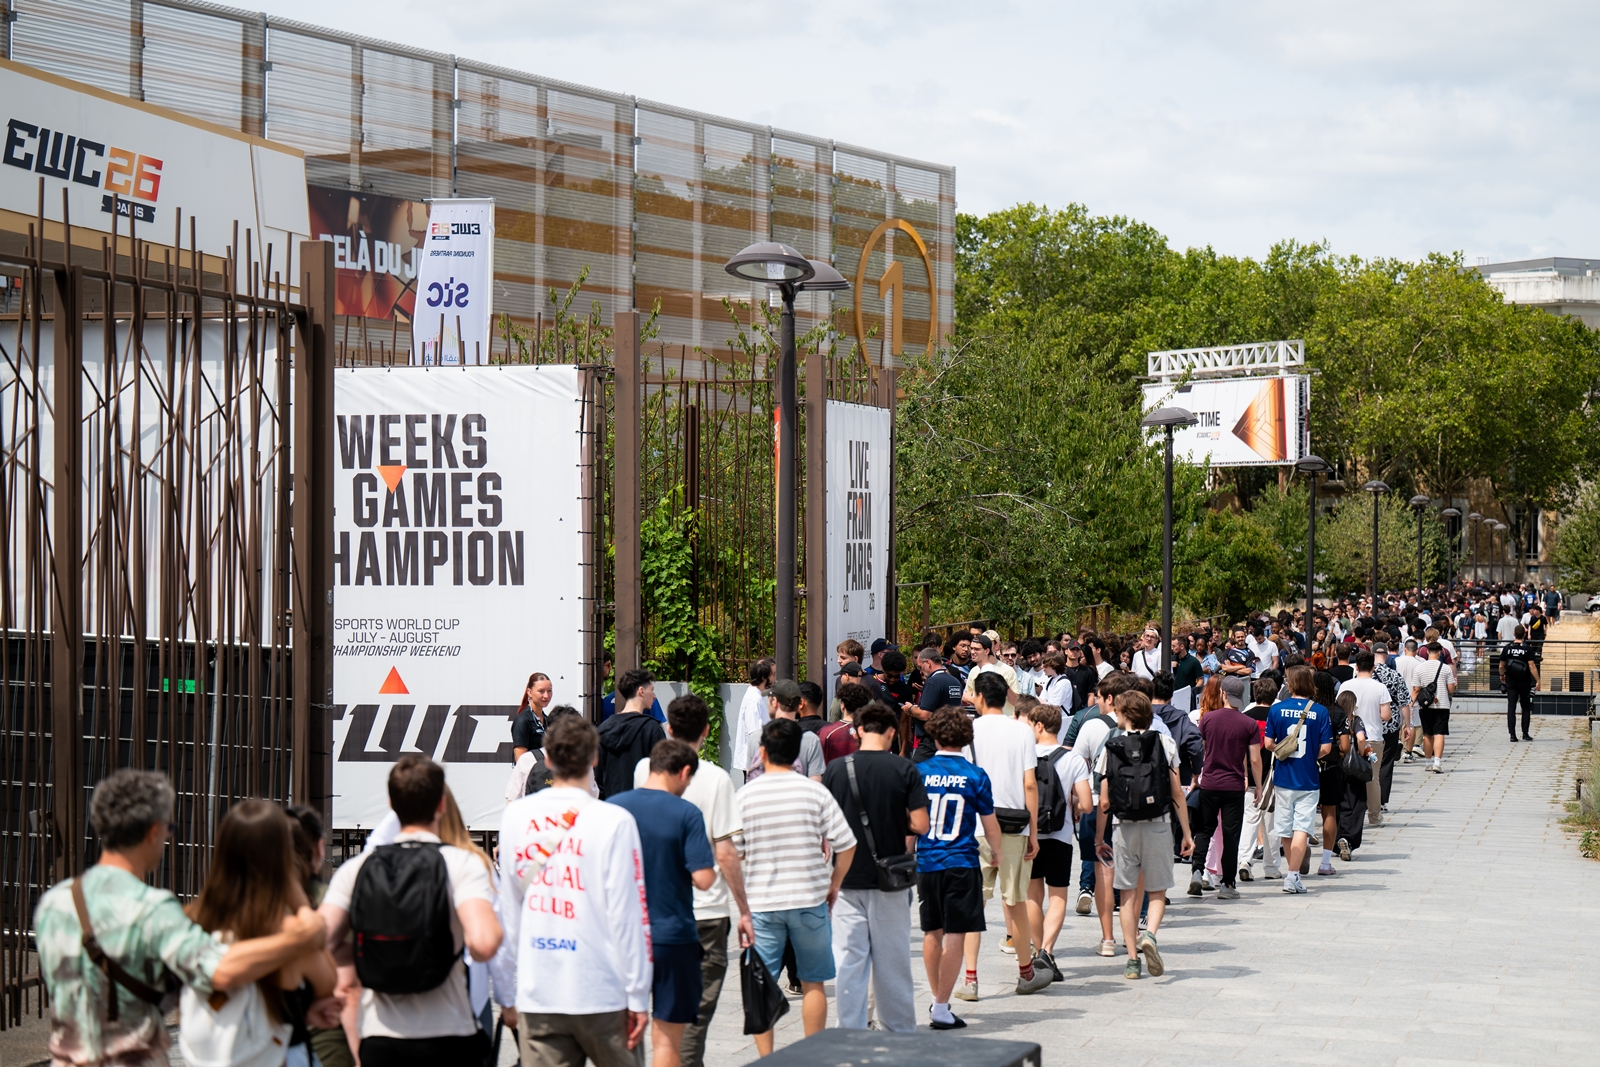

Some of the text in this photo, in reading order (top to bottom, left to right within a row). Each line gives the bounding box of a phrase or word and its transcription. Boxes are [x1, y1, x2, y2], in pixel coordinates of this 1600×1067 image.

[319, 230, 371, 272] ELÀ
[374, 240, 401, 277] DU
[879, 261, 903, 356] 1
[337, 413, 488, 469] WEEKS
[1199, 411, 1221, 428] TIME
[849, 440, 870, 490] LIVE
[352, 472, 503, 528] GAMES
[846, 491, 872, 540] FROM
[845, 542, 872, 592] PARIS
[334, 618, 460, 630] SPORTS WORLD CUP
[347, 632, 378, 643] JULY
[389, 632, 440, 643] AUGUST
[409, 645, 461, 657] WEEKEND
[333, 704, 520, 763] WC
[924, 775, 967, 788] MBAPPE
[926, 792, 966, 842] 10
[527, 894, 576, 920] CLUB
